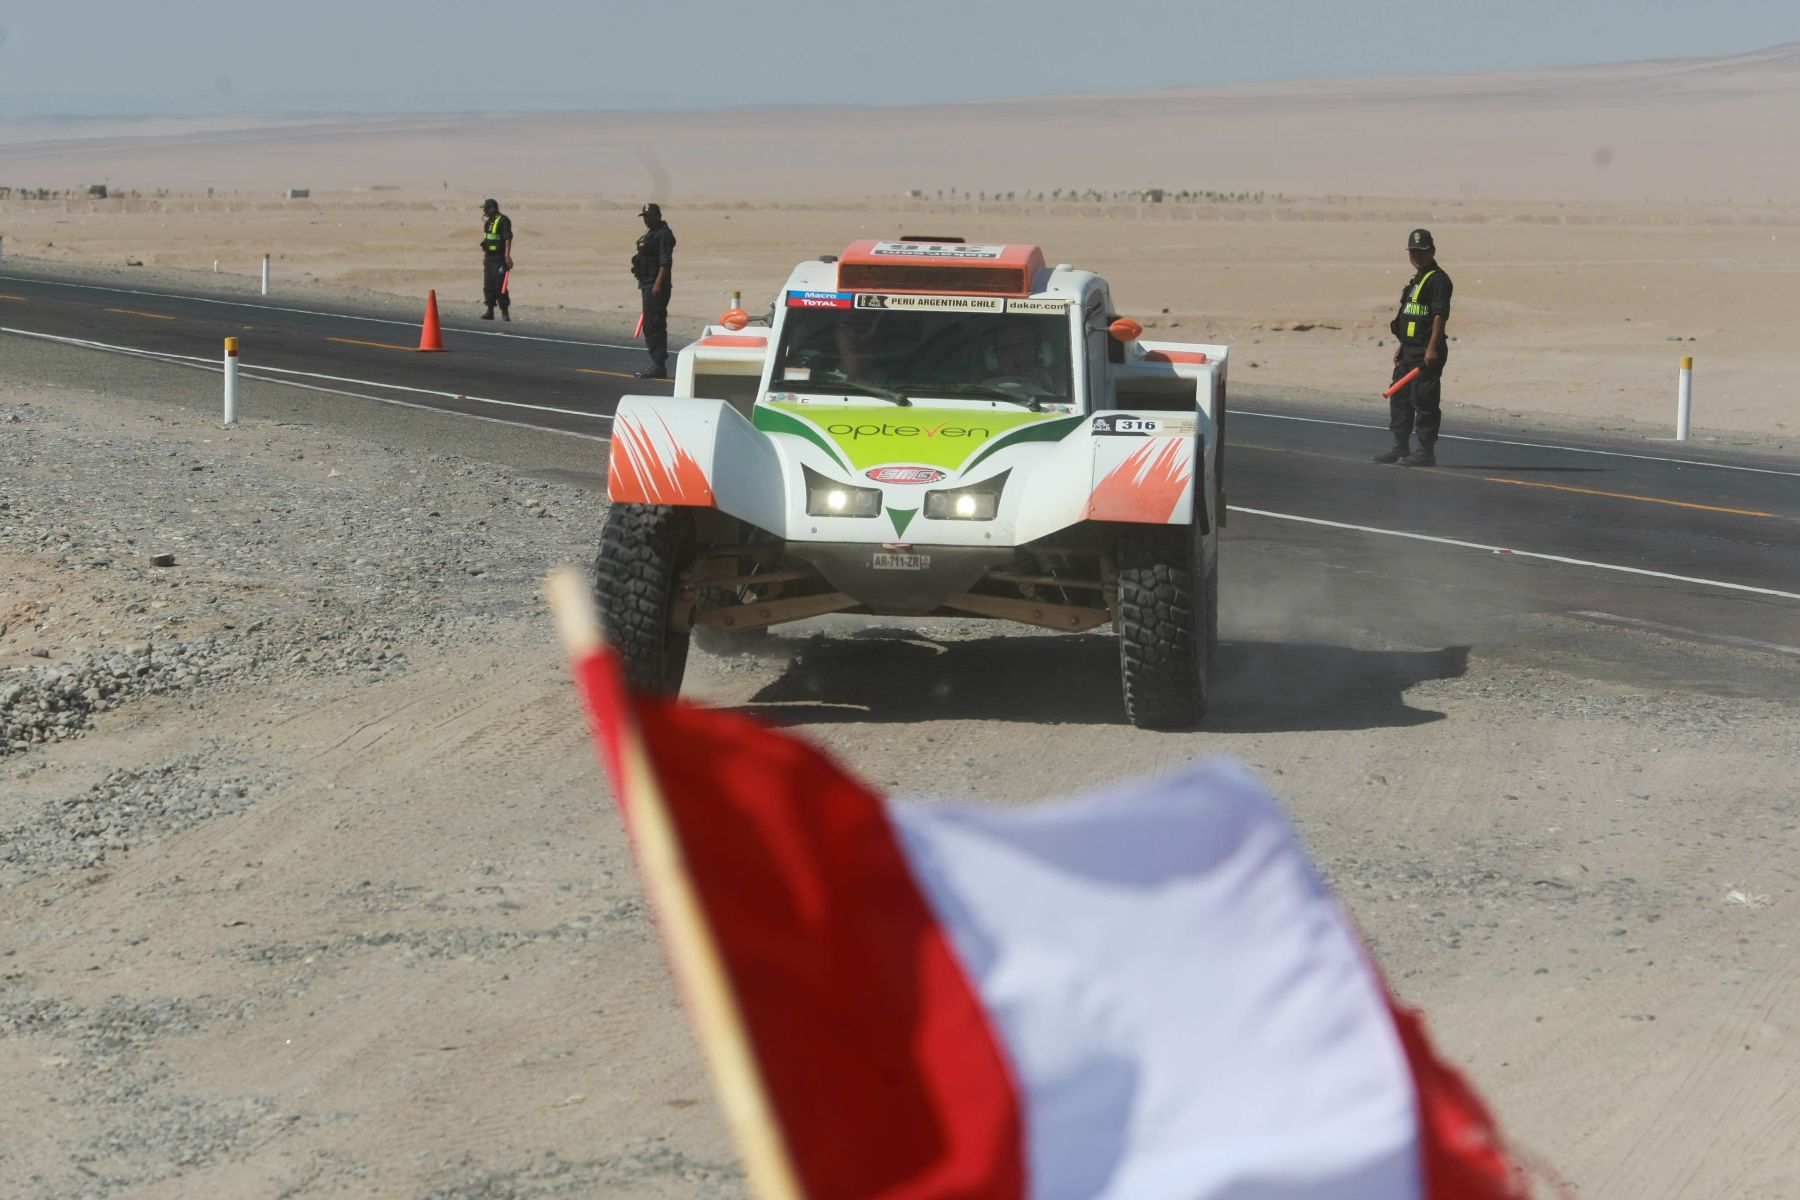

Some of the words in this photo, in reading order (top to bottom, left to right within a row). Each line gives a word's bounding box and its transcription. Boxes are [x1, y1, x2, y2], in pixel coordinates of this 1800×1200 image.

[801, 299, 837, 307] TOTAL
[891, 298, 915, 306] PERU
[918, 299, 968, 307] ARGENTINA
[971, 300, 996, 308] CHILE
[827, 420, 989, 440] opteven
[1122, 421, 1156, 430] 316
[875, 555, 919, 568] AR-711-ZR
